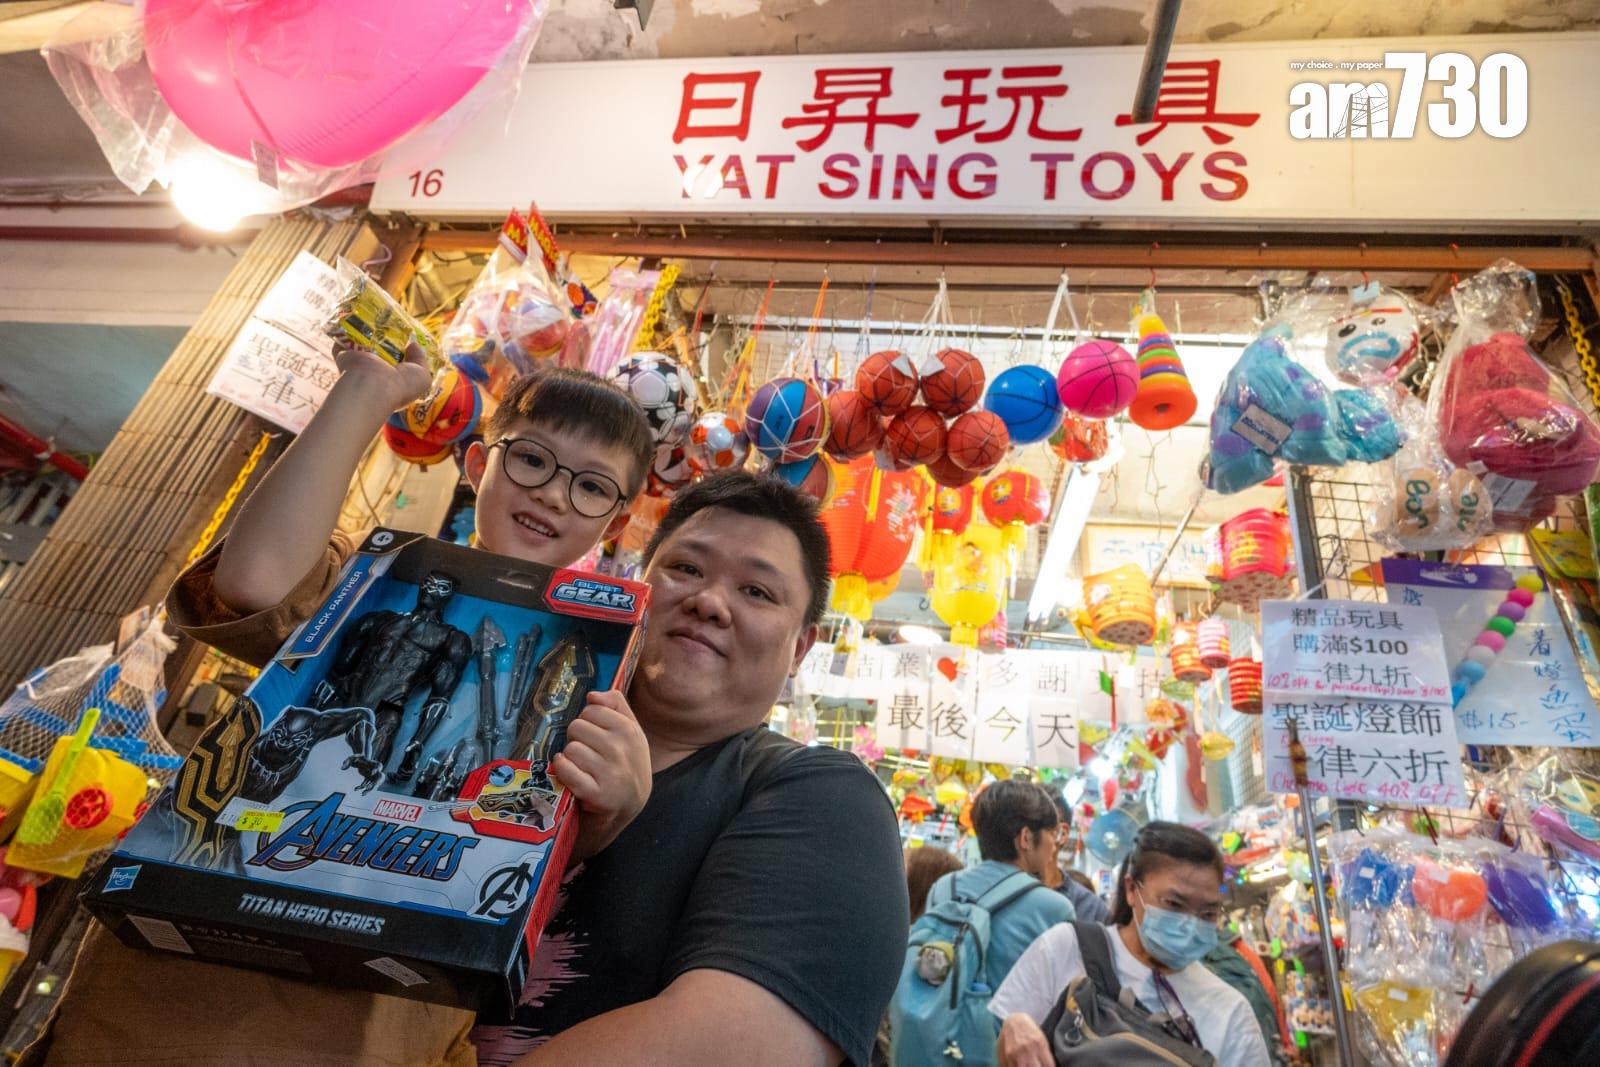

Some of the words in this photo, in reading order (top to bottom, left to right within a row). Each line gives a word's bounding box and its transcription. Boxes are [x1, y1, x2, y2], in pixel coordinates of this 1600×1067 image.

[672, 59, 1260, 152] 日昇玩具
[408, 169, 444, 198] 16
[673, 153, 795, 200] YAT
[817, 152, 998, 199] SING
[1029, 151, 1249, 200] TOYS
[555, 585, 632, 608] GEAR
[576, 580, 622, 593] BLAST
[305, 611, 333, 643] BLACK
[328, 570, 364, 611] PANTHER
[1290, 607, 1404, 631] 精品玩具
[1292, 633, 1409, 656] 購滿$100
[1295, 661, 1412, 688] 一律九折
[888, 694, 1075, 750] 最後今天
[1272, 702, 1442, 737] 聖誕燈飾
[1273, 745, 1450, 785] 一律六折
[375, 800, 420, 822] MARVEL
[237, 892, 287, 919] TITAN
[284, 901, 328, 926] HERO
[325, 908, 386, 936] SERIES
